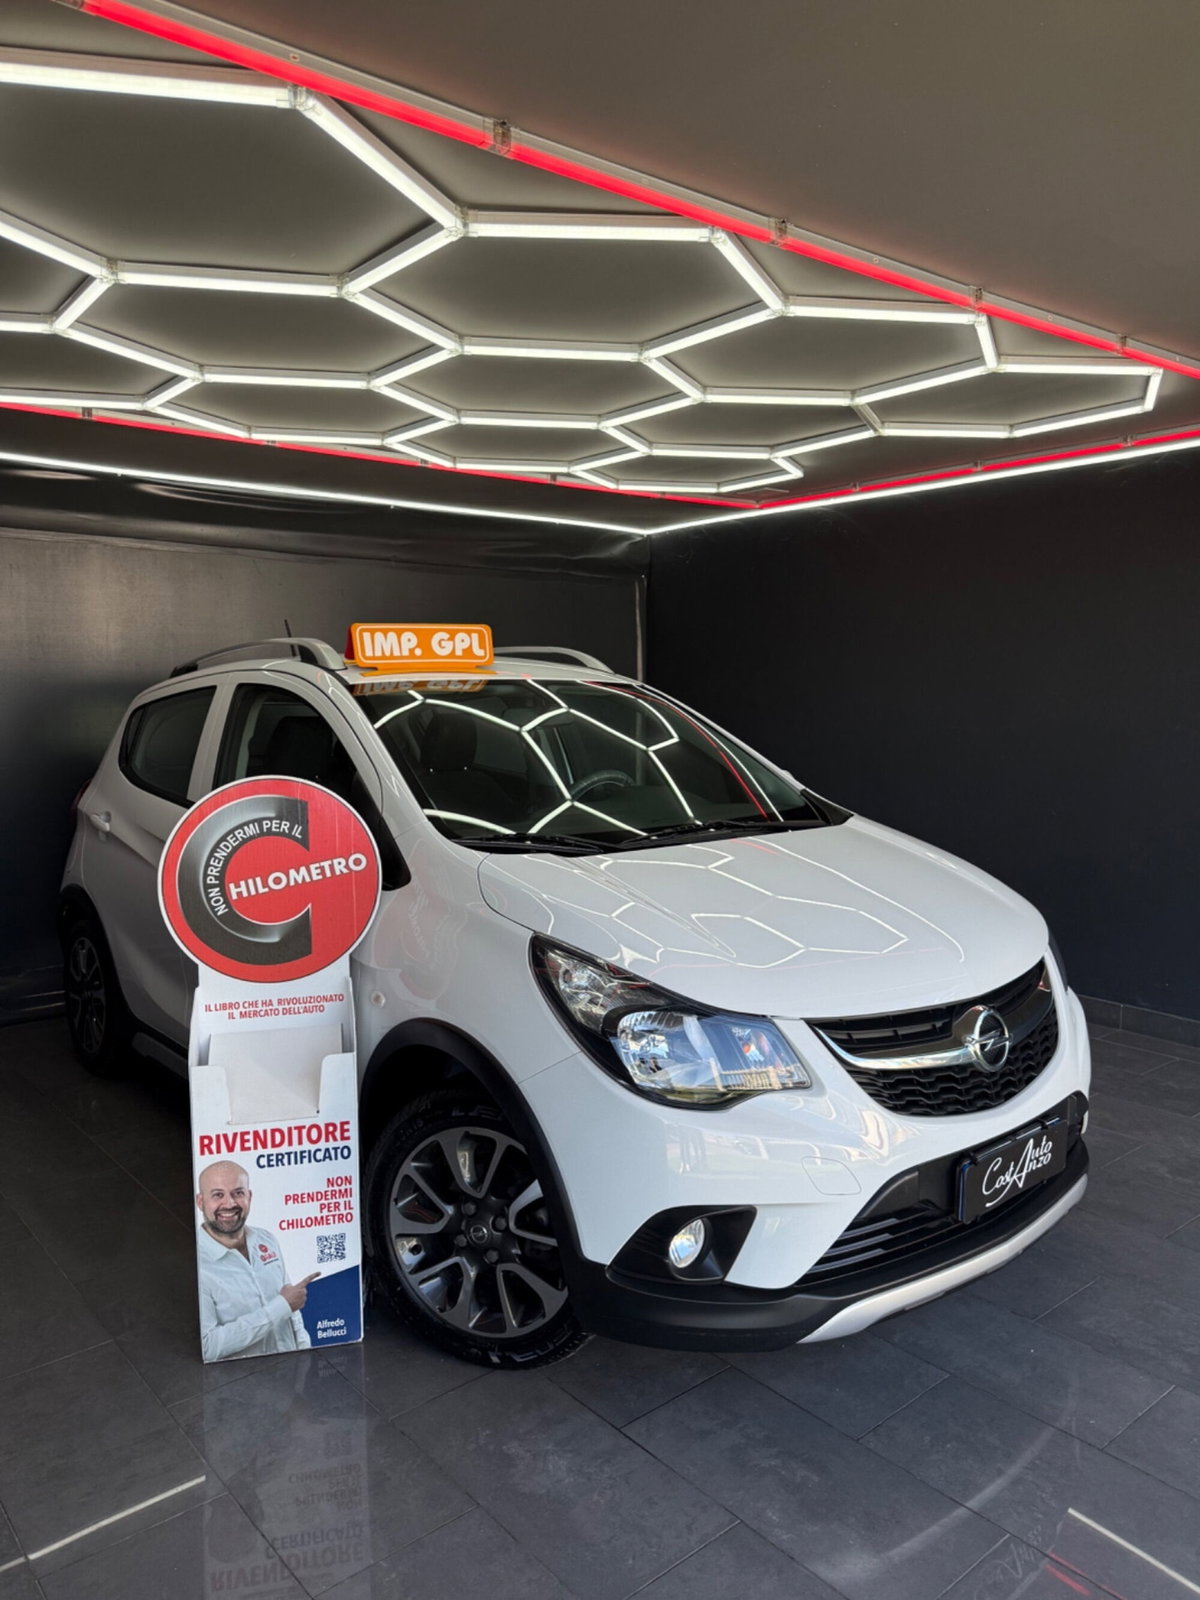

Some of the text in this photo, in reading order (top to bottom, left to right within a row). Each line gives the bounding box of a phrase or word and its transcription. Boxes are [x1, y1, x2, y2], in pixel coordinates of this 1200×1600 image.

[362, 631, 485, 657] IMP. GPL
[206, 820, 303, 917] NON PRENDERMI PER IL
[204, 993, 345, 1013] IL LIBRO CHE HA RIVOLUZIONATO
[228, 1004, 325, 1020] IL MERCATO DELL'AUTO
[198, 1121, 351, 1156] RIVENDITORE
[256, 1145, 352, 1169] CERTIFICATO
[326, 1175, 353, 1188] NON
[284, 1188, 353, 1205] PRENDERMI
[319, 1200, 354, 1214] PER IL
[278, 1212, 353, 1231] CHILOMETRO
[316, 1318, 345, 1329] Alfredo
[317, 1327, 347, 1339] Bellucci
